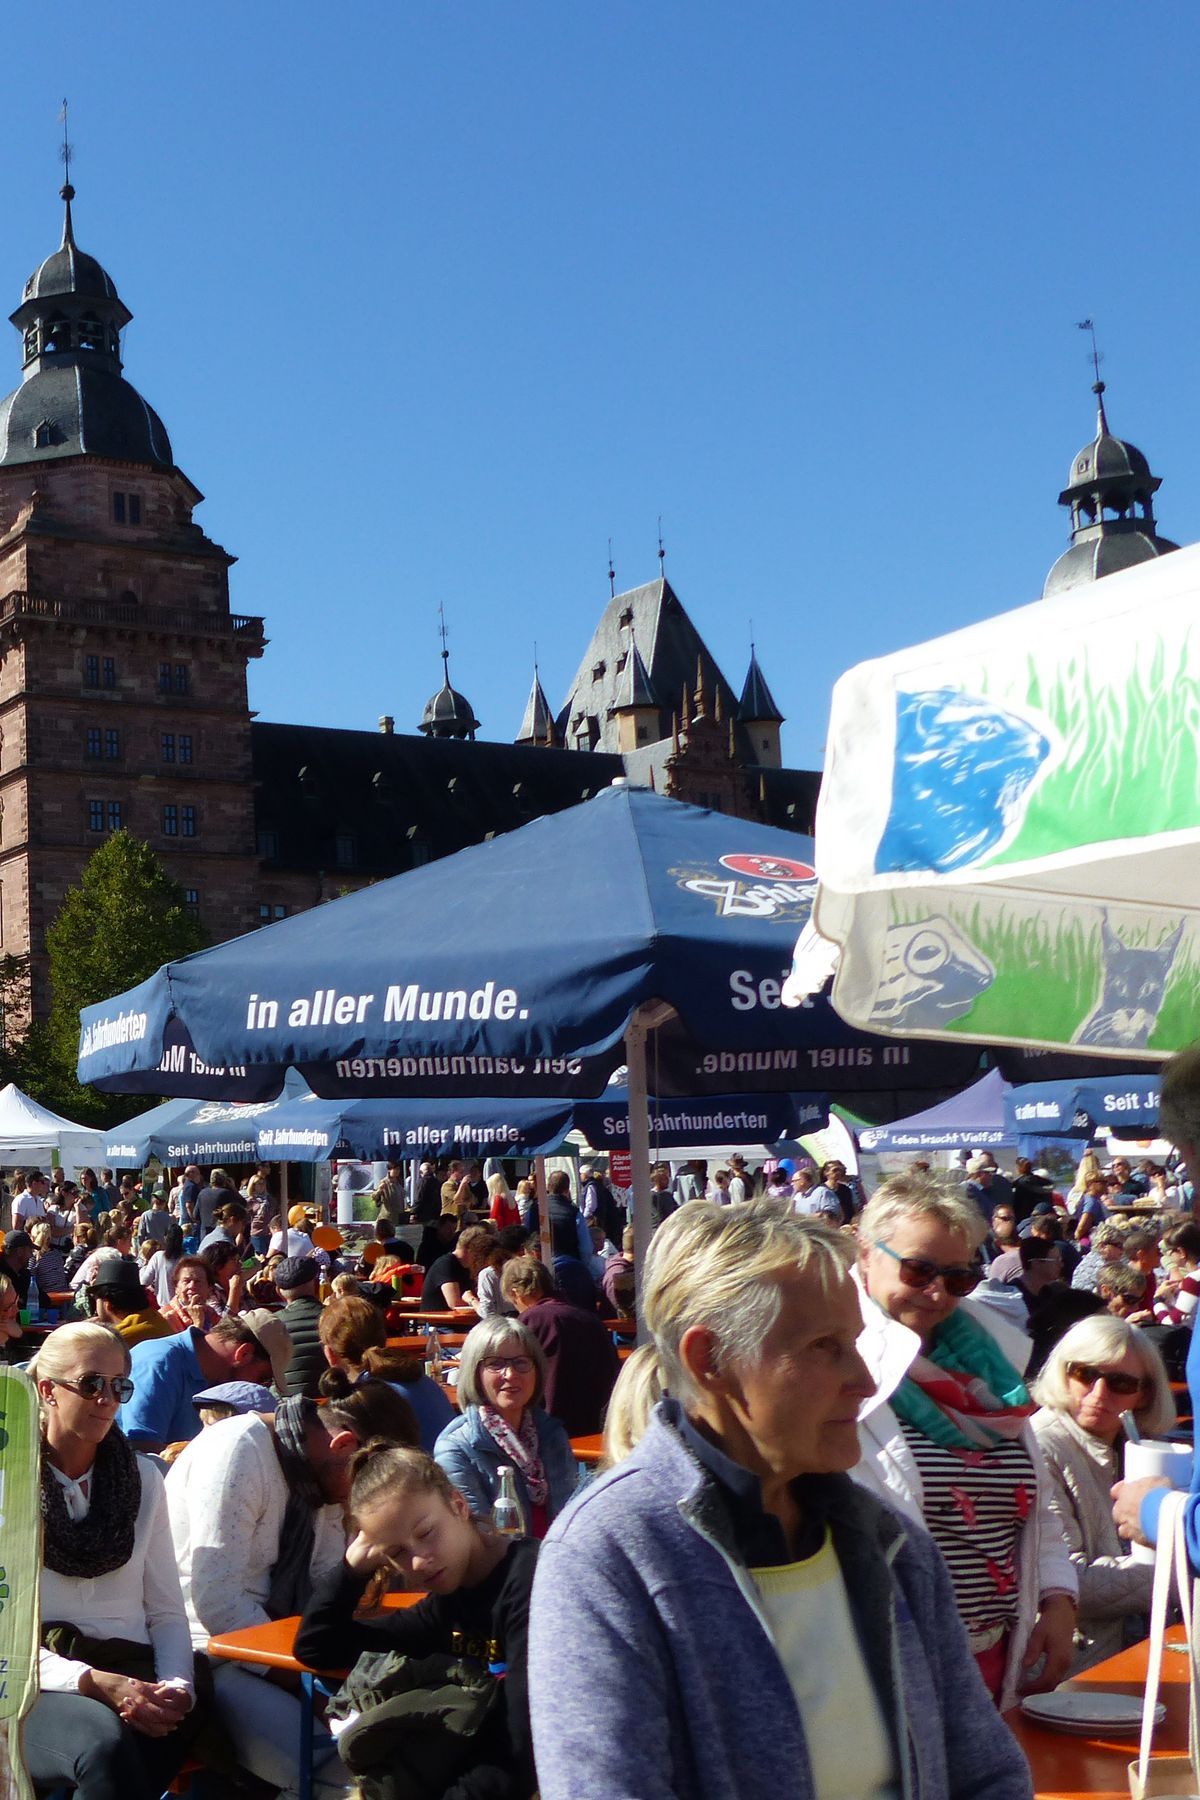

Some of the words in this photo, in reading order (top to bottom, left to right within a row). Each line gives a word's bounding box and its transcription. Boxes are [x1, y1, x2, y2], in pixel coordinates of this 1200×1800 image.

[246, 995, 278, 1029] in
[289, 989, 374, 1025] aller
[383, 981, 529, 1022] Munde.
[1104, 1092, 1141, 1112] Seit
[258, 1129, 274, 1147] Seit
[274, 1128, 328, 1146] Jahrhunderten
[384, 1128, 400, 1146] in
[406, 1126, 448, 1145] aller
[453, 1124, 526, 1143] Munde.
[892, 1134, 919, 1144] Leben
[920, 1133, 959, 1144] braucht
[960, 1131, 1004, 1143] Vielfalt
[168, 1144, 189, 1157] Seit
